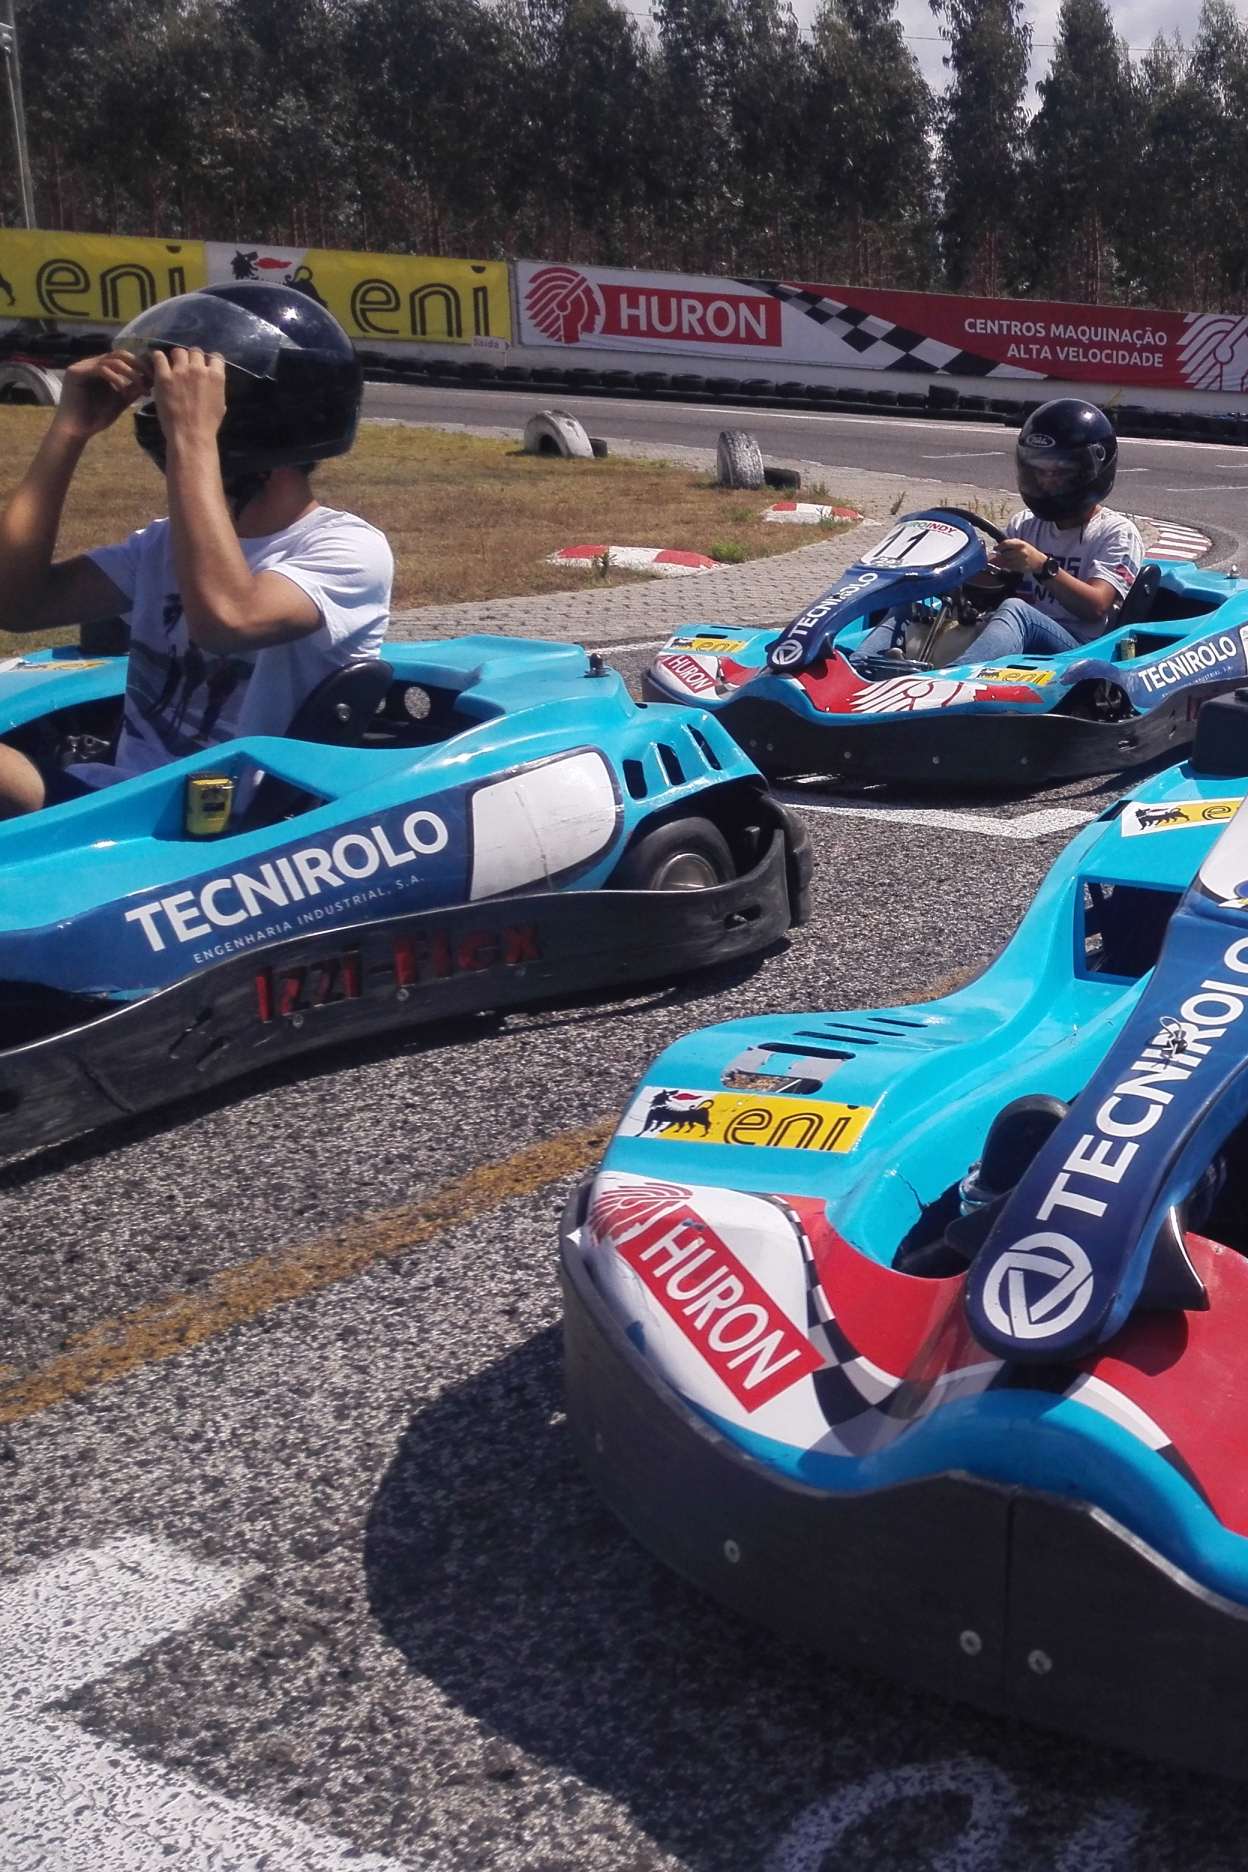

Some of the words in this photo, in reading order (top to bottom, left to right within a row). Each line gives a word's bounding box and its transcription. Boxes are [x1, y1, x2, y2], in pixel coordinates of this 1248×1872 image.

[36, 244, 187, 320] eni
[350, 265, 490, 337] eni
[619, 293, 768, 340] HURON
[964, 318, 1046, 337] CENTROS
[1050, 324, 1168, 347] MAQUINAÇÃO
[1007, 343, 1052, 360] ALTA
[1056, 346, 1164, 367] VELOCIDADE
[873, 526, 930, 560] 11
[899, 521, 958, 534] ROINDY
[788, 572, 878, 638] TECNIROLO
[668, 656, 713, 690] HURON
[1138, 636, 1237, 692] TECNIROLO
[125, 810, 450, 952] TECNIROLO
[193, 921, 293, 964] ENGENHARIA
[724, 1102, 860, 1151] eni
[638, 1223, 802, 1390] HURON
